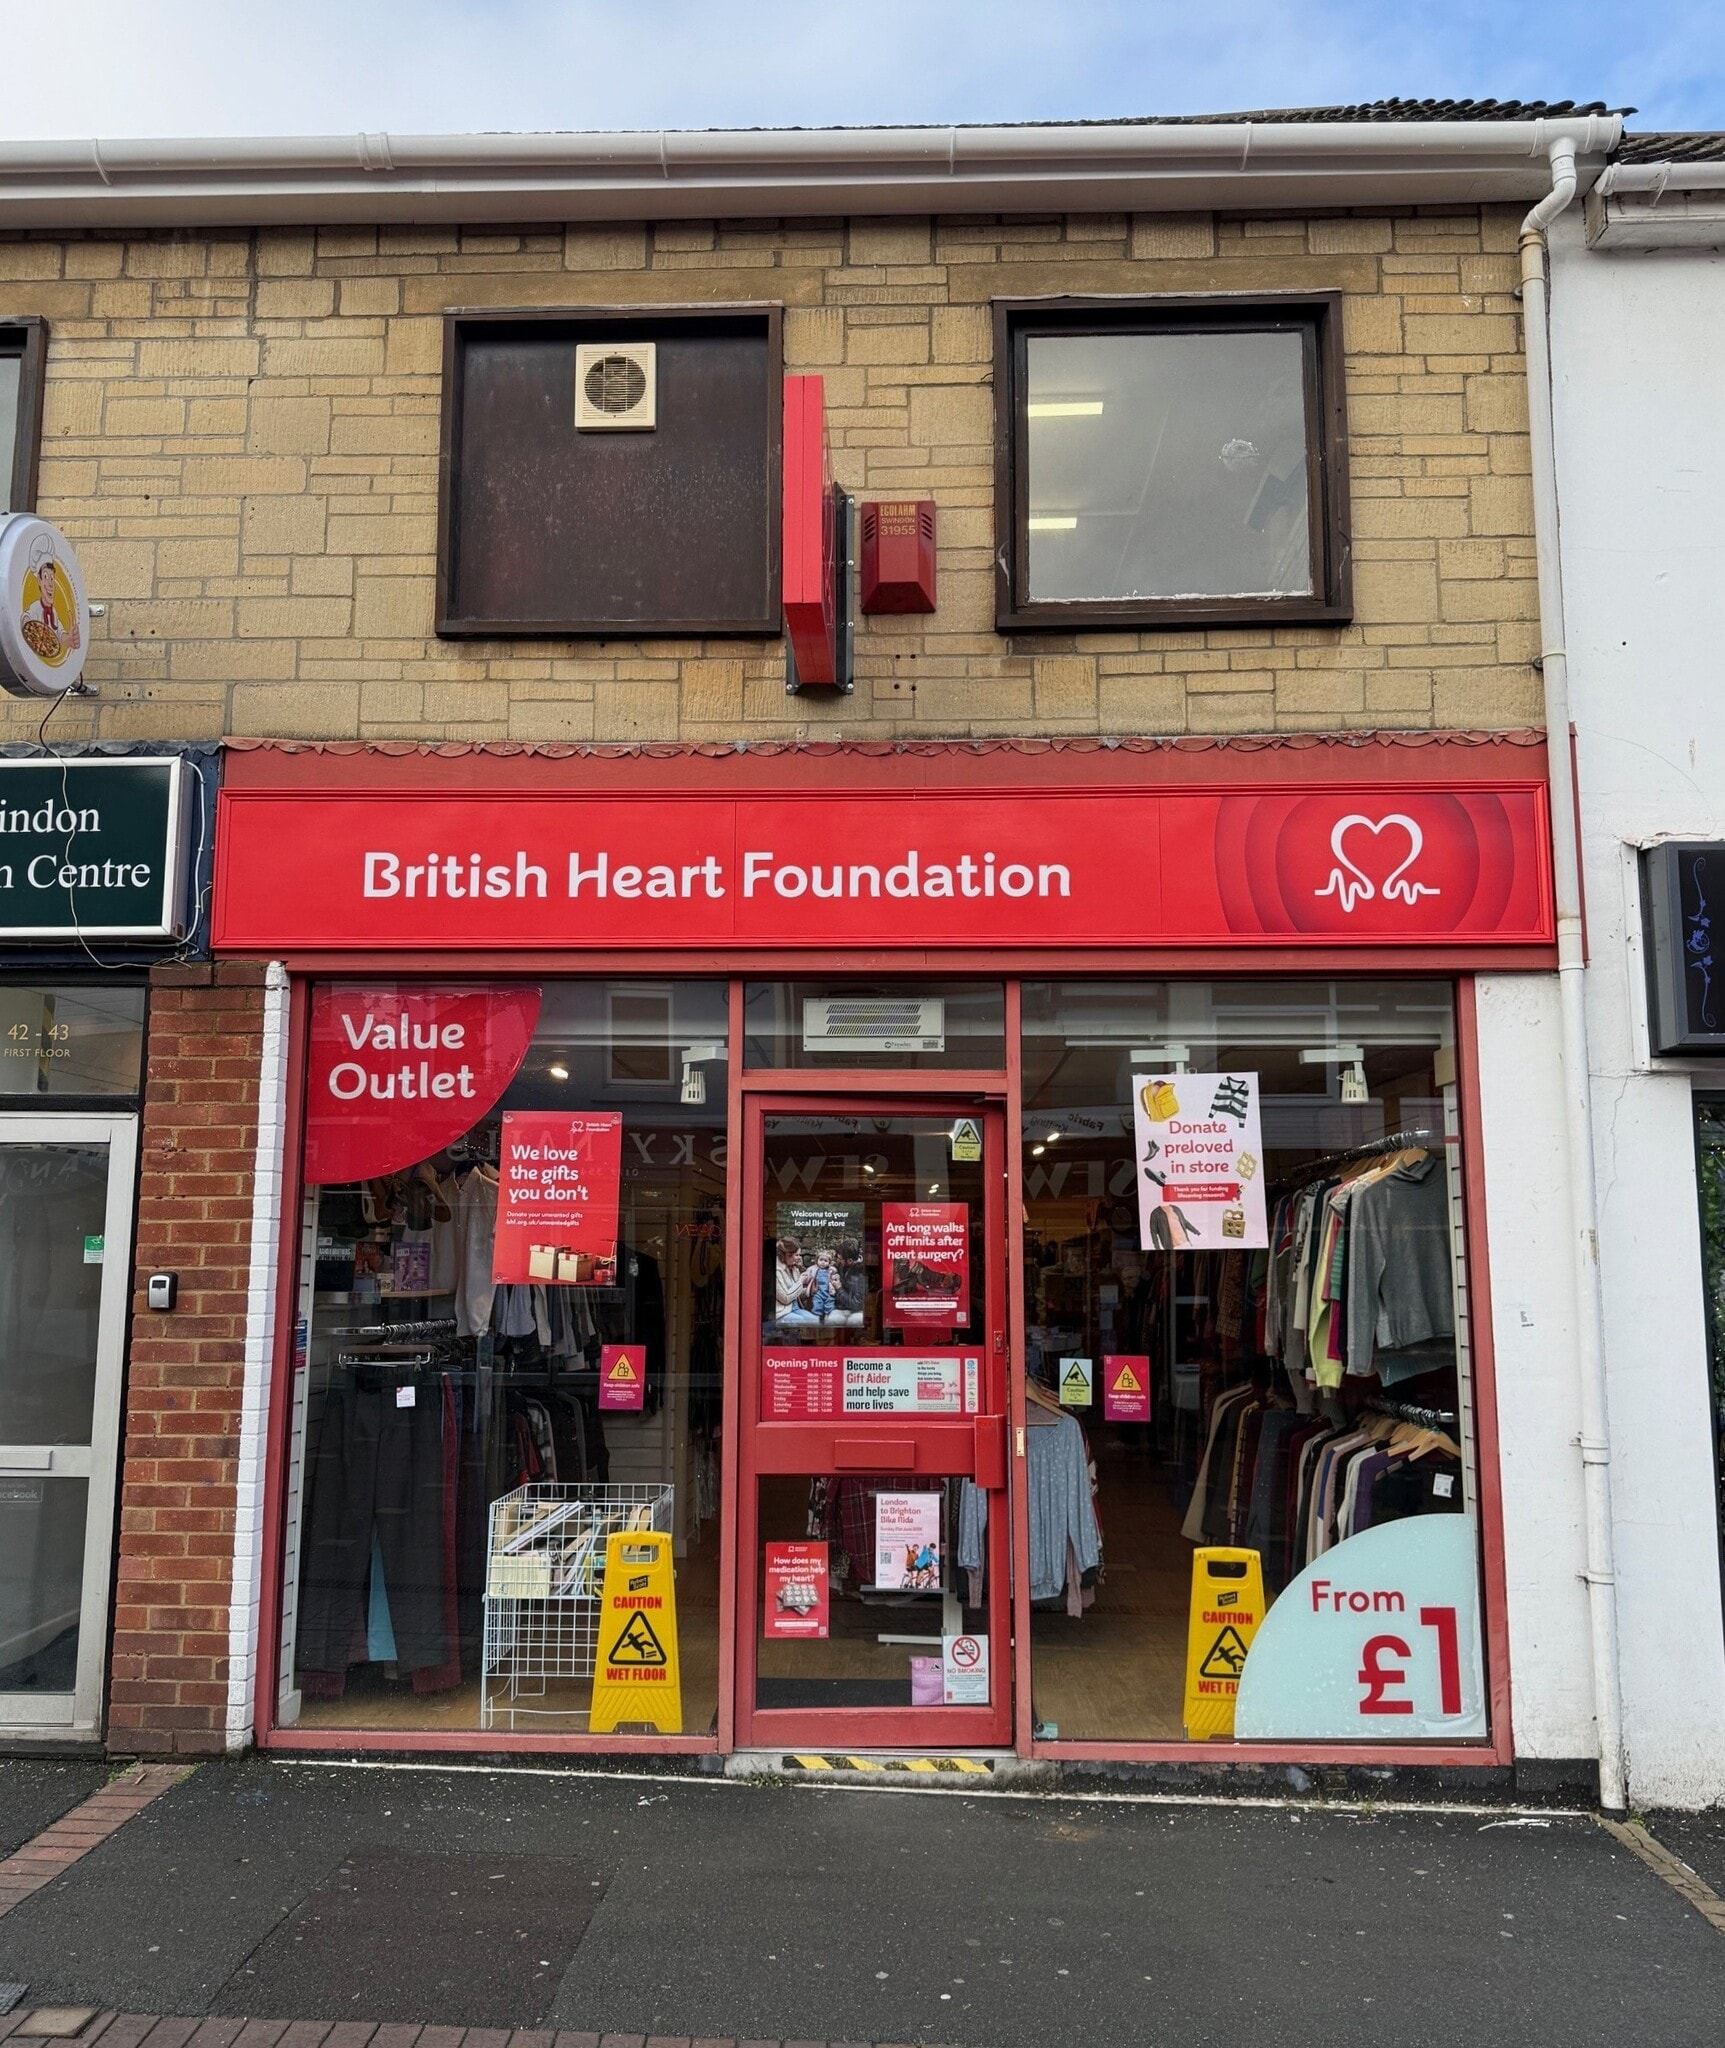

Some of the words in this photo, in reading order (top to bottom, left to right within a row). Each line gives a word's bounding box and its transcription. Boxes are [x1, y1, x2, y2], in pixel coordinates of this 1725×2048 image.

[881, 517, 915, 525] SWINDON
[880, 525, 916, 536] 31955
[0, 798, 101, 833] indon
[27, 854, 150, 889] Centre
[363, 850, 548, 899] British
[568, 851, 726, 899] Heart
[743, 850, 1071, 898] Foundation
[7, 1024, 29, 1040] 42
[48, 1024, 69, 1041] 43
[341, 1012, 466, 1051] Value
[4, 1048, 31, 1057] FIRST
[35, 1048, 71, 1057] FLOOR
[328, 1060, 477, 1100] Outlet
[1169, 1120, 1227, 1134] Donate
[510, 1145, 540, 1160] We
[543, 1145, 578, 1160] love
[1164, 1139, 1233, 1158] preloved
[1171, 1160, 1185, 1173] in
[1189, 1160, 1229, 1173] store
[509, 1164, 538, 1180] the
[541, 1165, 579, 1185] gifts
[509, 1188, 540, 1204] you
[544, 1184, 589, 1200] don't
[1209, 1185, 1229, 1193] funding
[794, 1219, 811, 1227] local
[812, 1219, 827, 1227] BHF
[886, 1222, 905, 1233] Are
[906, 1221, 931, 1235] long
[932, 1221, 965, 1233] walks
[888, 1235, 905, 1246] off
[906, 1235, 936, 1246] limits
[937, 1235, 964, 1246] after
[887, 1248, 916, 1260] heart
[917, 1248, 965, 1262] surgery?
[767, 1358, 808, 1370] Opening
[809, 1358, 838, 1368] Times
[846, 1360, 884, 1371] Become
[885, 1362, 892, 1371] a
[846, 1372, 864, 1384] Gift
[866, 1372, 891, 1384] Aider
[846, 1386, 864, 1397] and
[866, 1386, 886, 1399] help
[888, 1388, 910, 1397] save
[846, 1401, 871, 1410] more
[872, 1399, 894, 1410] lives
[880, 1498, 908, 1506] London
[890, 1507, 921, 1516] Brighton
[880, 1516, 897, 1524] Bike
[897, 1516, 914, 1524] Ride
[773, 1556, 790, 1565] How
[791, 1556, 808, 1565] does
[809, 1557, 822, 1567] my
[768, 1565, 809, 1574] medication
[809, 1566, 826, 1575] help
[779, 1576, 792, 1585] my
[613, 1596, 662, 1609] CAUTION
[1311, 1580, 1405, 1612] From
[1202, 1611, 1253, 1625] CAUTION
[1358, 1607, 1462, 1715] £1
[606, 1668, 630, 1681] WET
[632, 1668, 666, 1681] FLOOR
[1198, 1680, 1224, 1694] WET
